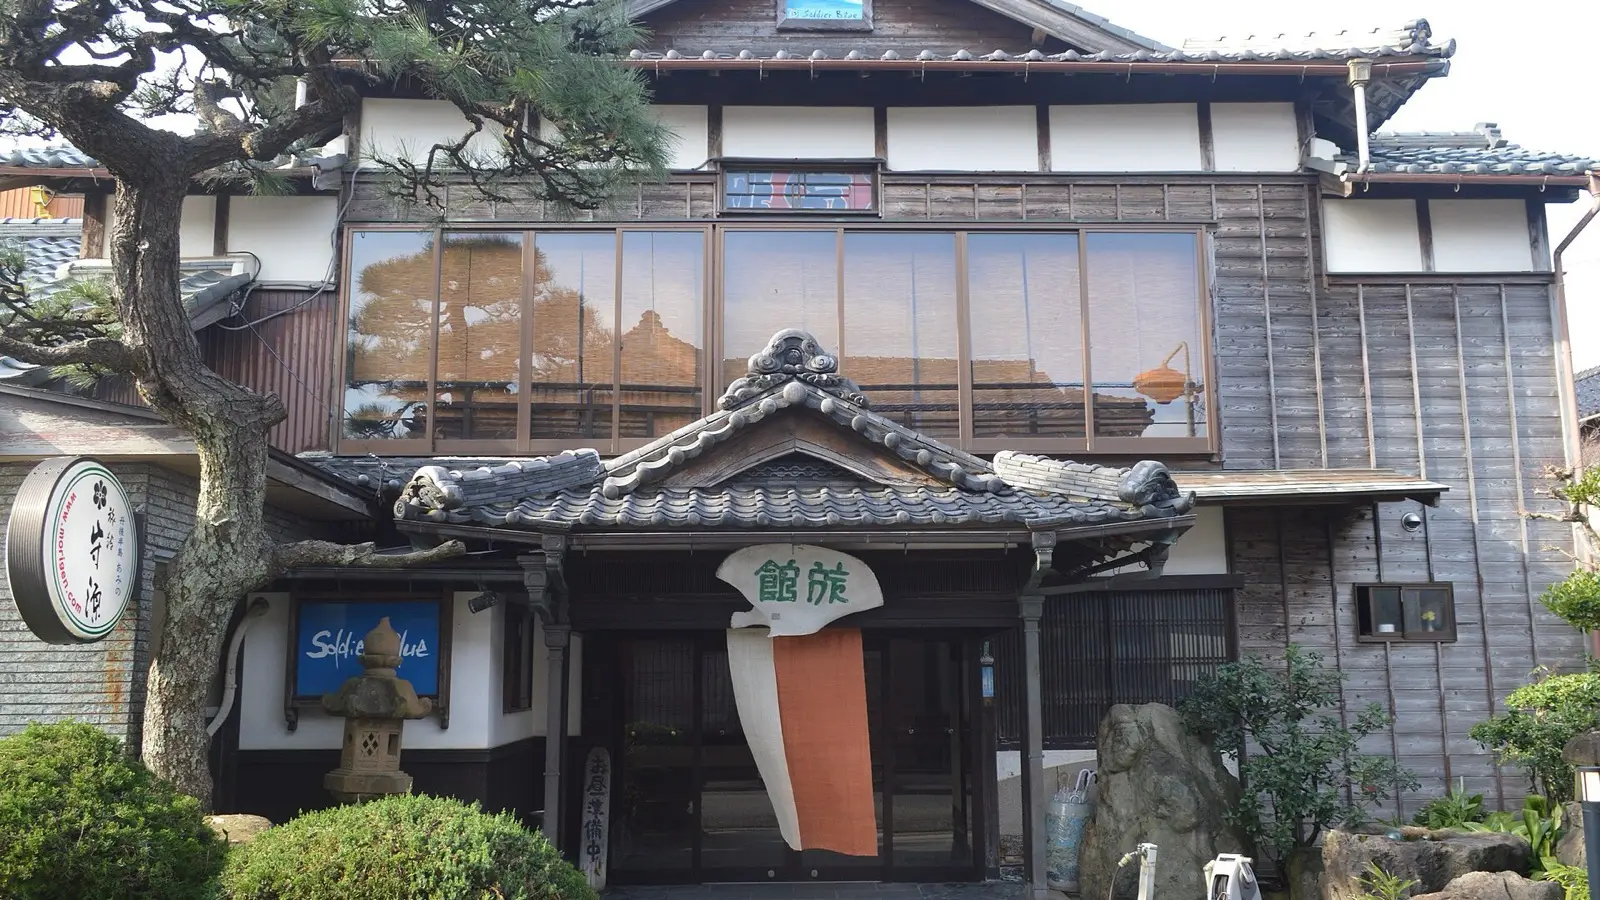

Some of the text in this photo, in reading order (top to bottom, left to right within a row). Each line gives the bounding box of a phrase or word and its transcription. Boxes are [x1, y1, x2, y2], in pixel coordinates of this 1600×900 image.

[802, 9, 832, 18] Soldier
[836, 10, 858, 18] Blue
[306, 628, 429, 669] Soldie lue
[584, 755, 608, 862] お昼準備中
